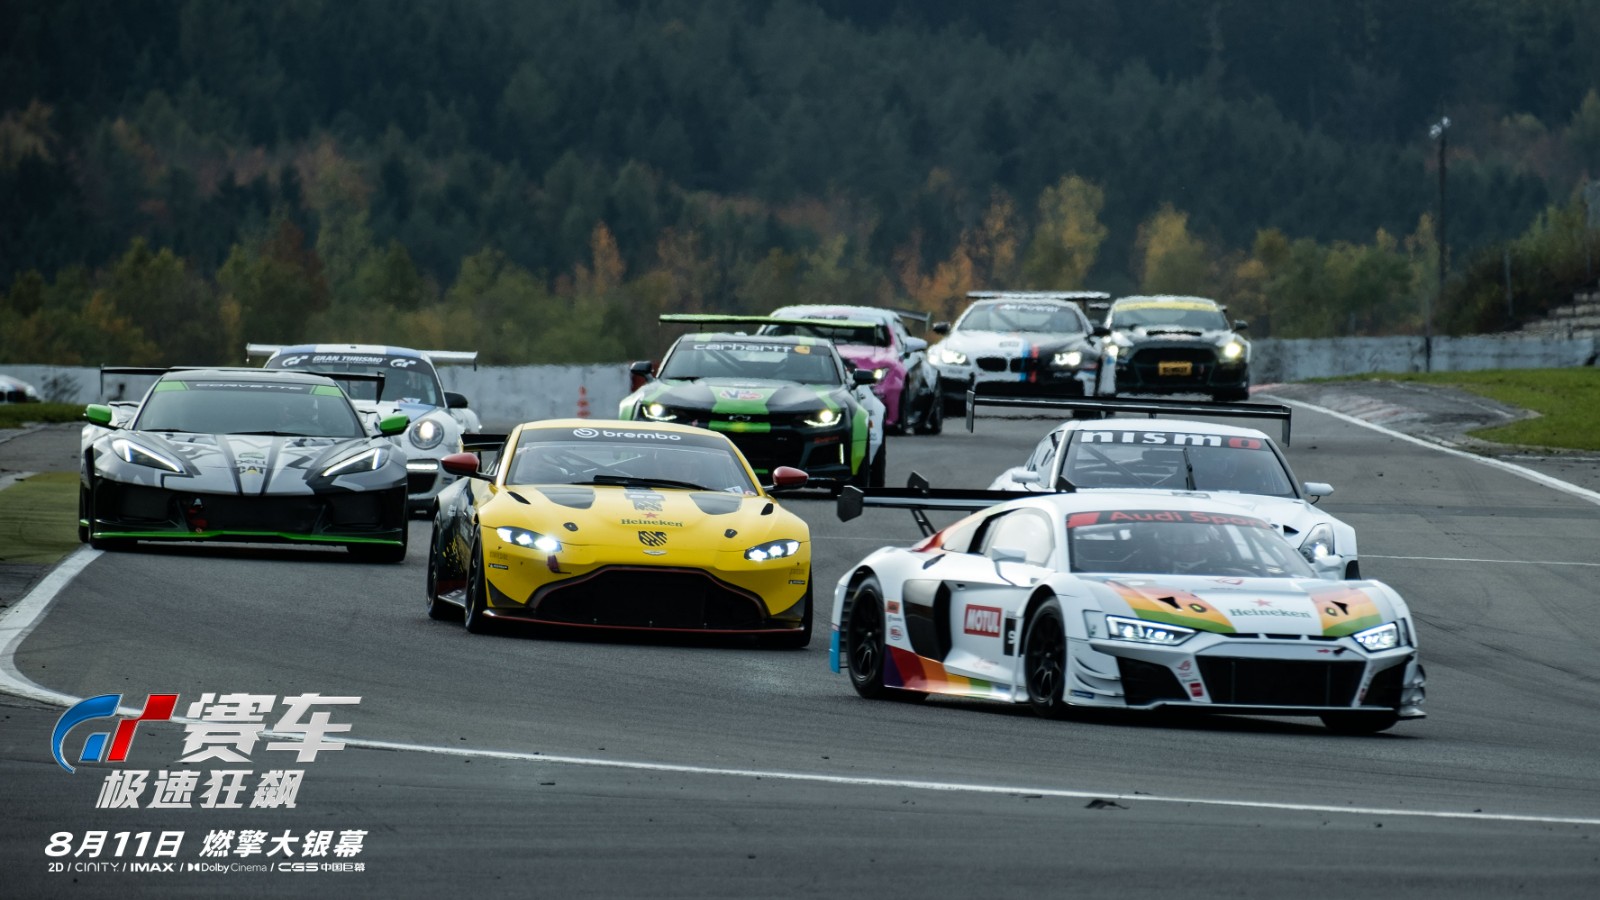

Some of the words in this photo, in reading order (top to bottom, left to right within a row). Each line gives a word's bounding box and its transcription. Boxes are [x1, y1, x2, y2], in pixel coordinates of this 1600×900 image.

[693, 343, 792, 353] carhartt
[341, 355, 383, 363] TURISMO
[602, 430, 682, 441] brembo
[1080, 431, 1262, 449] nismo
[620, 518, 684, 528] Heineken
[1110, 511, 1183, 521] Audi
[1189, 511, 1271, 530] Spor
[1229, 608, 1313, 619] Heineken
[965, 608, 1001, 634] MOTUL
